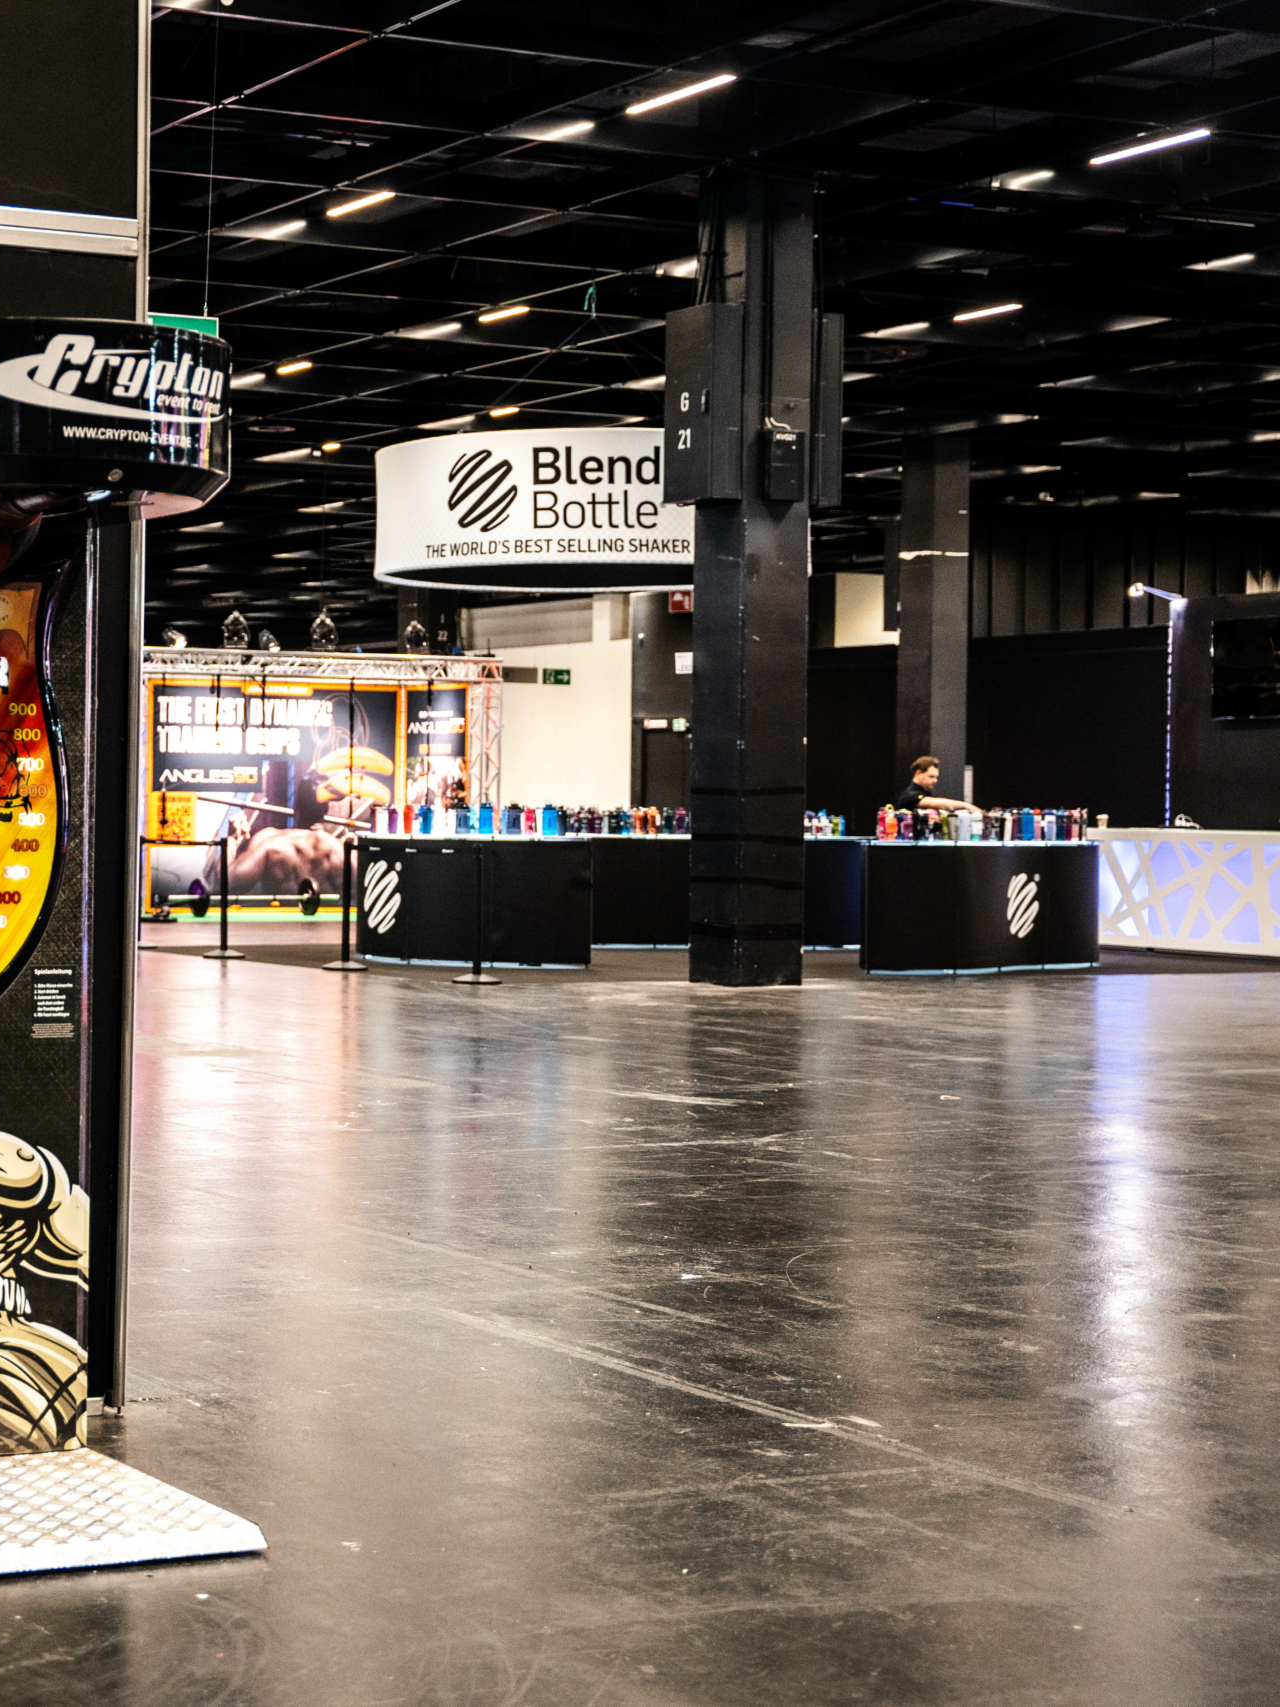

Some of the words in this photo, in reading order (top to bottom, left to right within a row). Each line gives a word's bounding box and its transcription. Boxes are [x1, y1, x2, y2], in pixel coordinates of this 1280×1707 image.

[39, 334, 224, 399] Crypton
[156, 393, 190, 409] event
[192, 397, 204, 411] to
[204, 399, 221, 415] rent
[677, 428, 692, 450] 21
[532, 445, 661, 485] Blend
[532, 489, 659, 529] Bottle
[425, 543, 447, 559] THE
[450, 539, 511, 557] WORLD'S
[514, 538, 553, 554] BEST
[557, 538, 624, 554] SELLING
[628, 538, 691, 554] SHAKER
[248, 685, 308, 695] ANLES90.COM
[8, 702, 37, 717] 900
[157, 696, 192, 724] THE
[195, 696, 245, 725] FIRST
[249, 697, 333, 727] DYNAMIC
[13, 727, 41, 741] 800
[157, 725, 243, 754] TRAINING
[245, 726, 301, 756] GRIPS
[16, 757, 44, 771] 700
[19, 784, 48, 798] 600
[17, 812, 46, 827] 500
[10, 838, 39, 852] 400
[2, 865, 30, 879] 300
